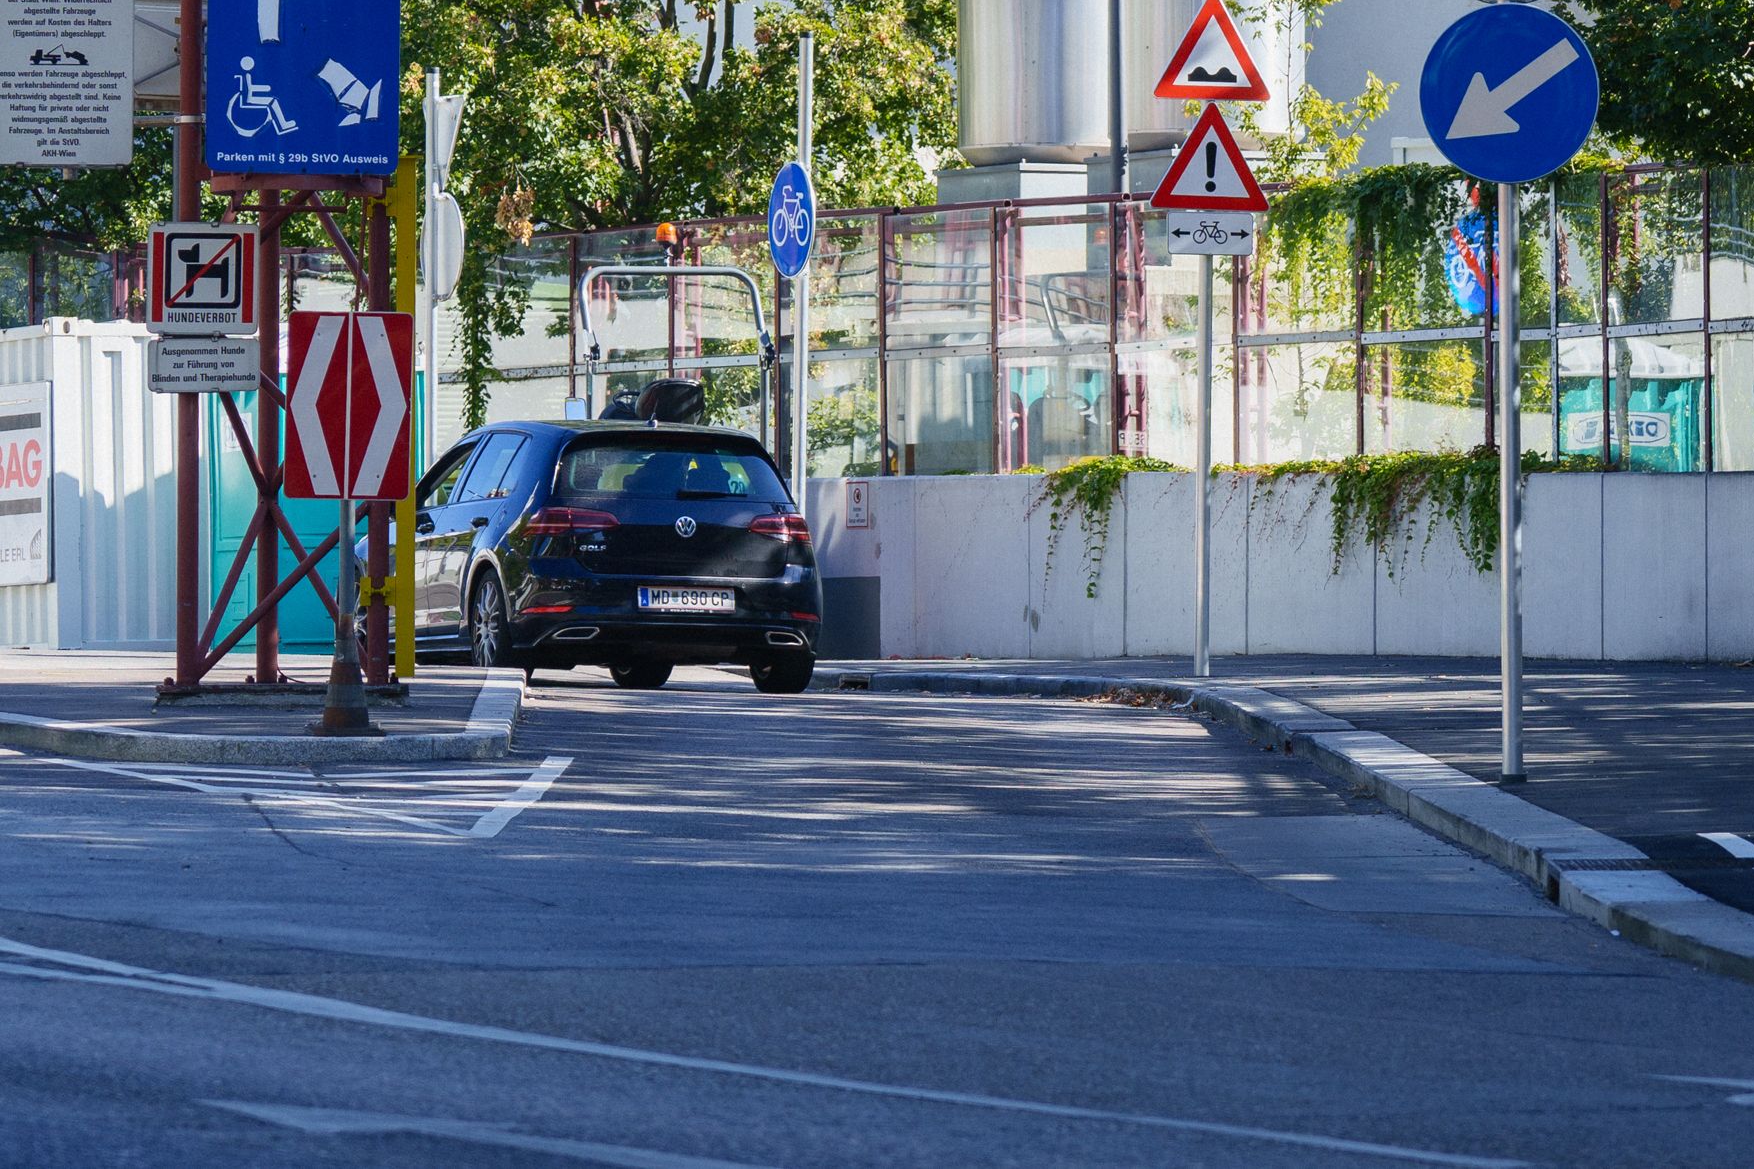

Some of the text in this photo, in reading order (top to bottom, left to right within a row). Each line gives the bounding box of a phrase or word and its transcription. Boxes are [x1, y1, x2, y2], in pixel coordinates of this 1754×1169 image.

[23, 6, 97, 17] abgestellte Fahrzeuge
[7, 18, 112, 27] werden auf Kosten des Halters
[12, 29, 107, 39] (Eigentümers) abgeschleppt.
[17, 69, 44, 78] werden
[45, 69, 79, 80] Fahrzeuge
[1, 80, 118, 90] die verkehrsbehindernd oder sonst
[48, 92, 82, 102] abgestellt
[83, 92, 99, 101] sind.
[102, 92, 122, 101] Keine
[9, 103, 110, 113] Haftung für private oder nicht
[11, 115, 108, 125] widmungsgemäß abgestellte
[8, 126, 110, 136] Fahrzeuge. Im Anstaltsbereich
[36, 137, 81, 148] gilt die StVO.
[41, 149, 77, 158] AKH-Wien
[216, 151, 389, 165] Parken mit § 29b StVO Ausweis
[167, 312, 238, 324] HUNDEVERBOT
[161, 345, 246, 358] Ausgenommen Hunde
[187, 359, 218, 370] Führung
[151, 372, 256, 384] Blinden und Therapiehunde
[0, 438, 42, 490] AG
[579, 544, 606, 552] GOLF
[651, 589, 729, 607] MD 690 CP
